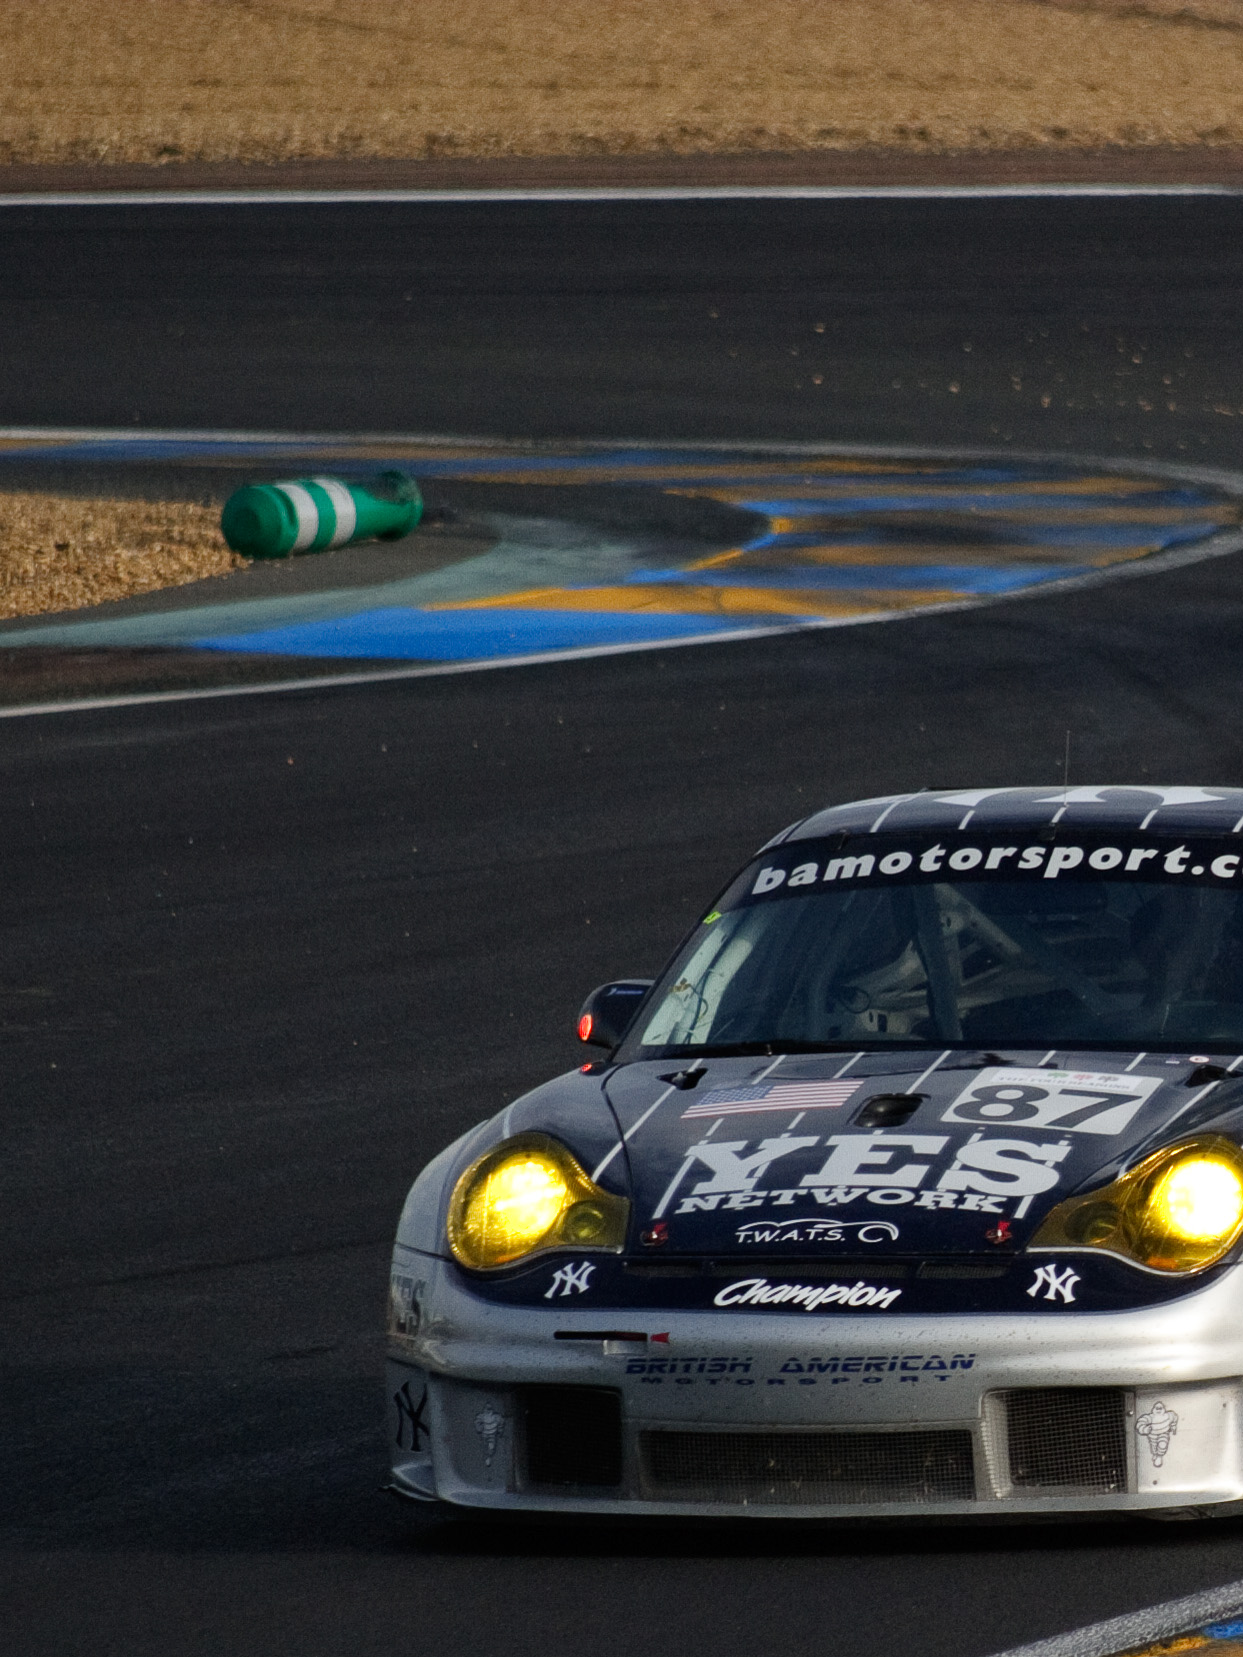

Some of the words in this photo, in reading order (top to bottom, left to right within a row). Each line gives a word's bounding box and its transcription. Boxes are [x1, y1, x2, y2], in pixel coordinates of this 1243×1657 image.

[953, 1084, 1144, 1129] 87
[685, 1133, 1073, 1197] YES
[675, 1187, 1007, 1215] NETWORK
[713, 1279, 903, 1311] Champion
[625, 1356, 755, 1375] BRITISH
[779, 1354, 976, 1374] AMERICAN
[641, 1374, 953, 1386] MOTORSPORT
